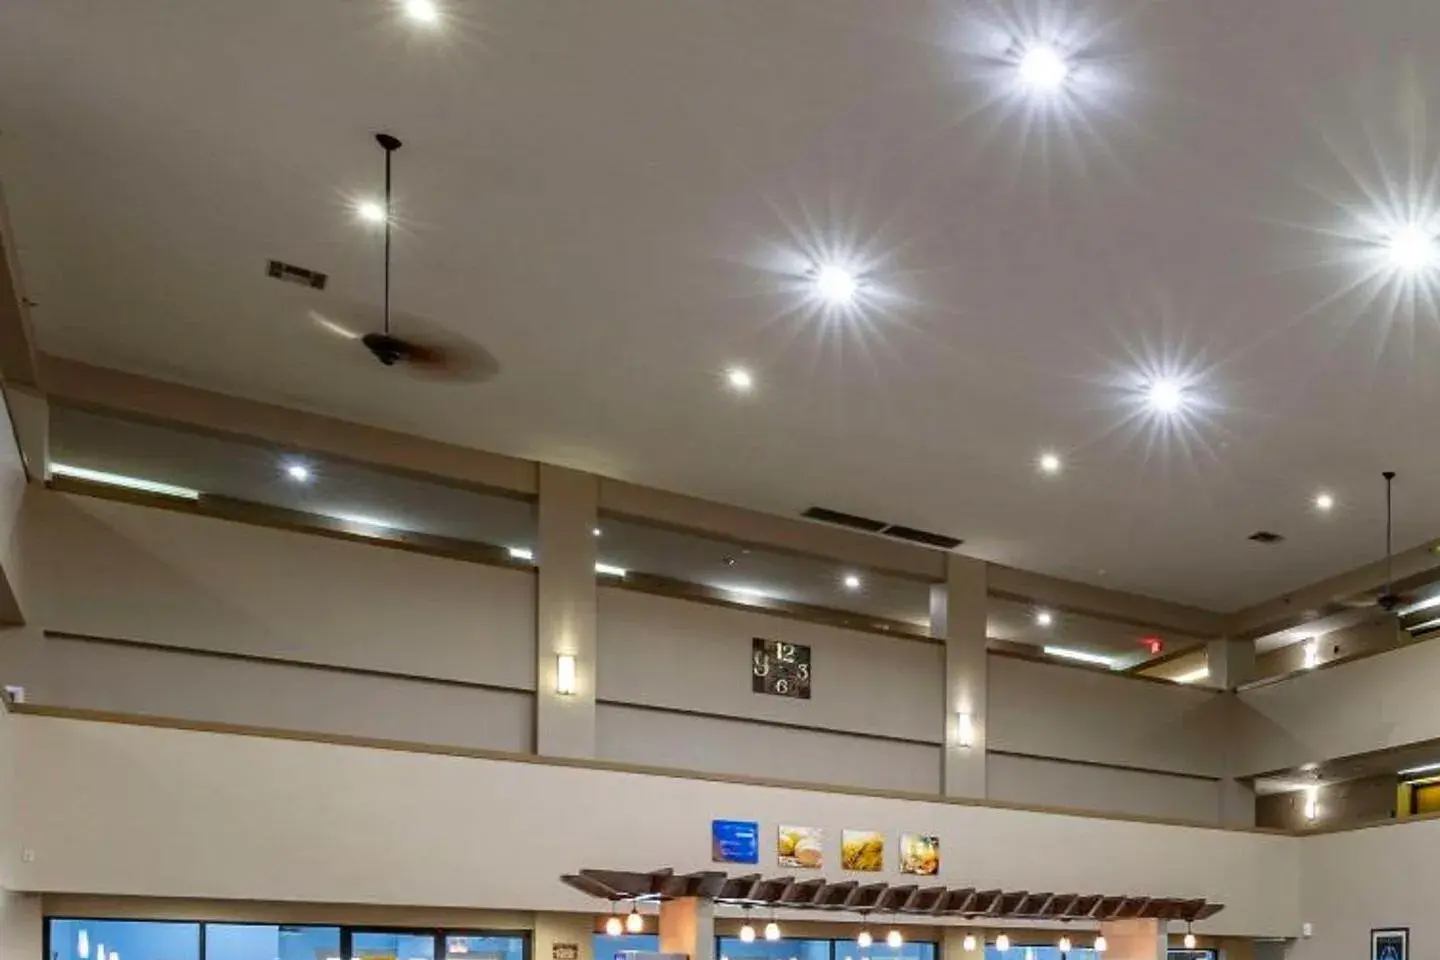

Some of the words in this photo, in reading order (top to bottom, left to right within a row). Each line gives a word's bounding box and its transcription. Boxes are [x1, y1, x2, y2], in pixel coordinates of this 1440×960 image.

[776, 642, 796, 663] 12
[797, 663, 809, 681] 3
[776, 679, 789, 694] 6
